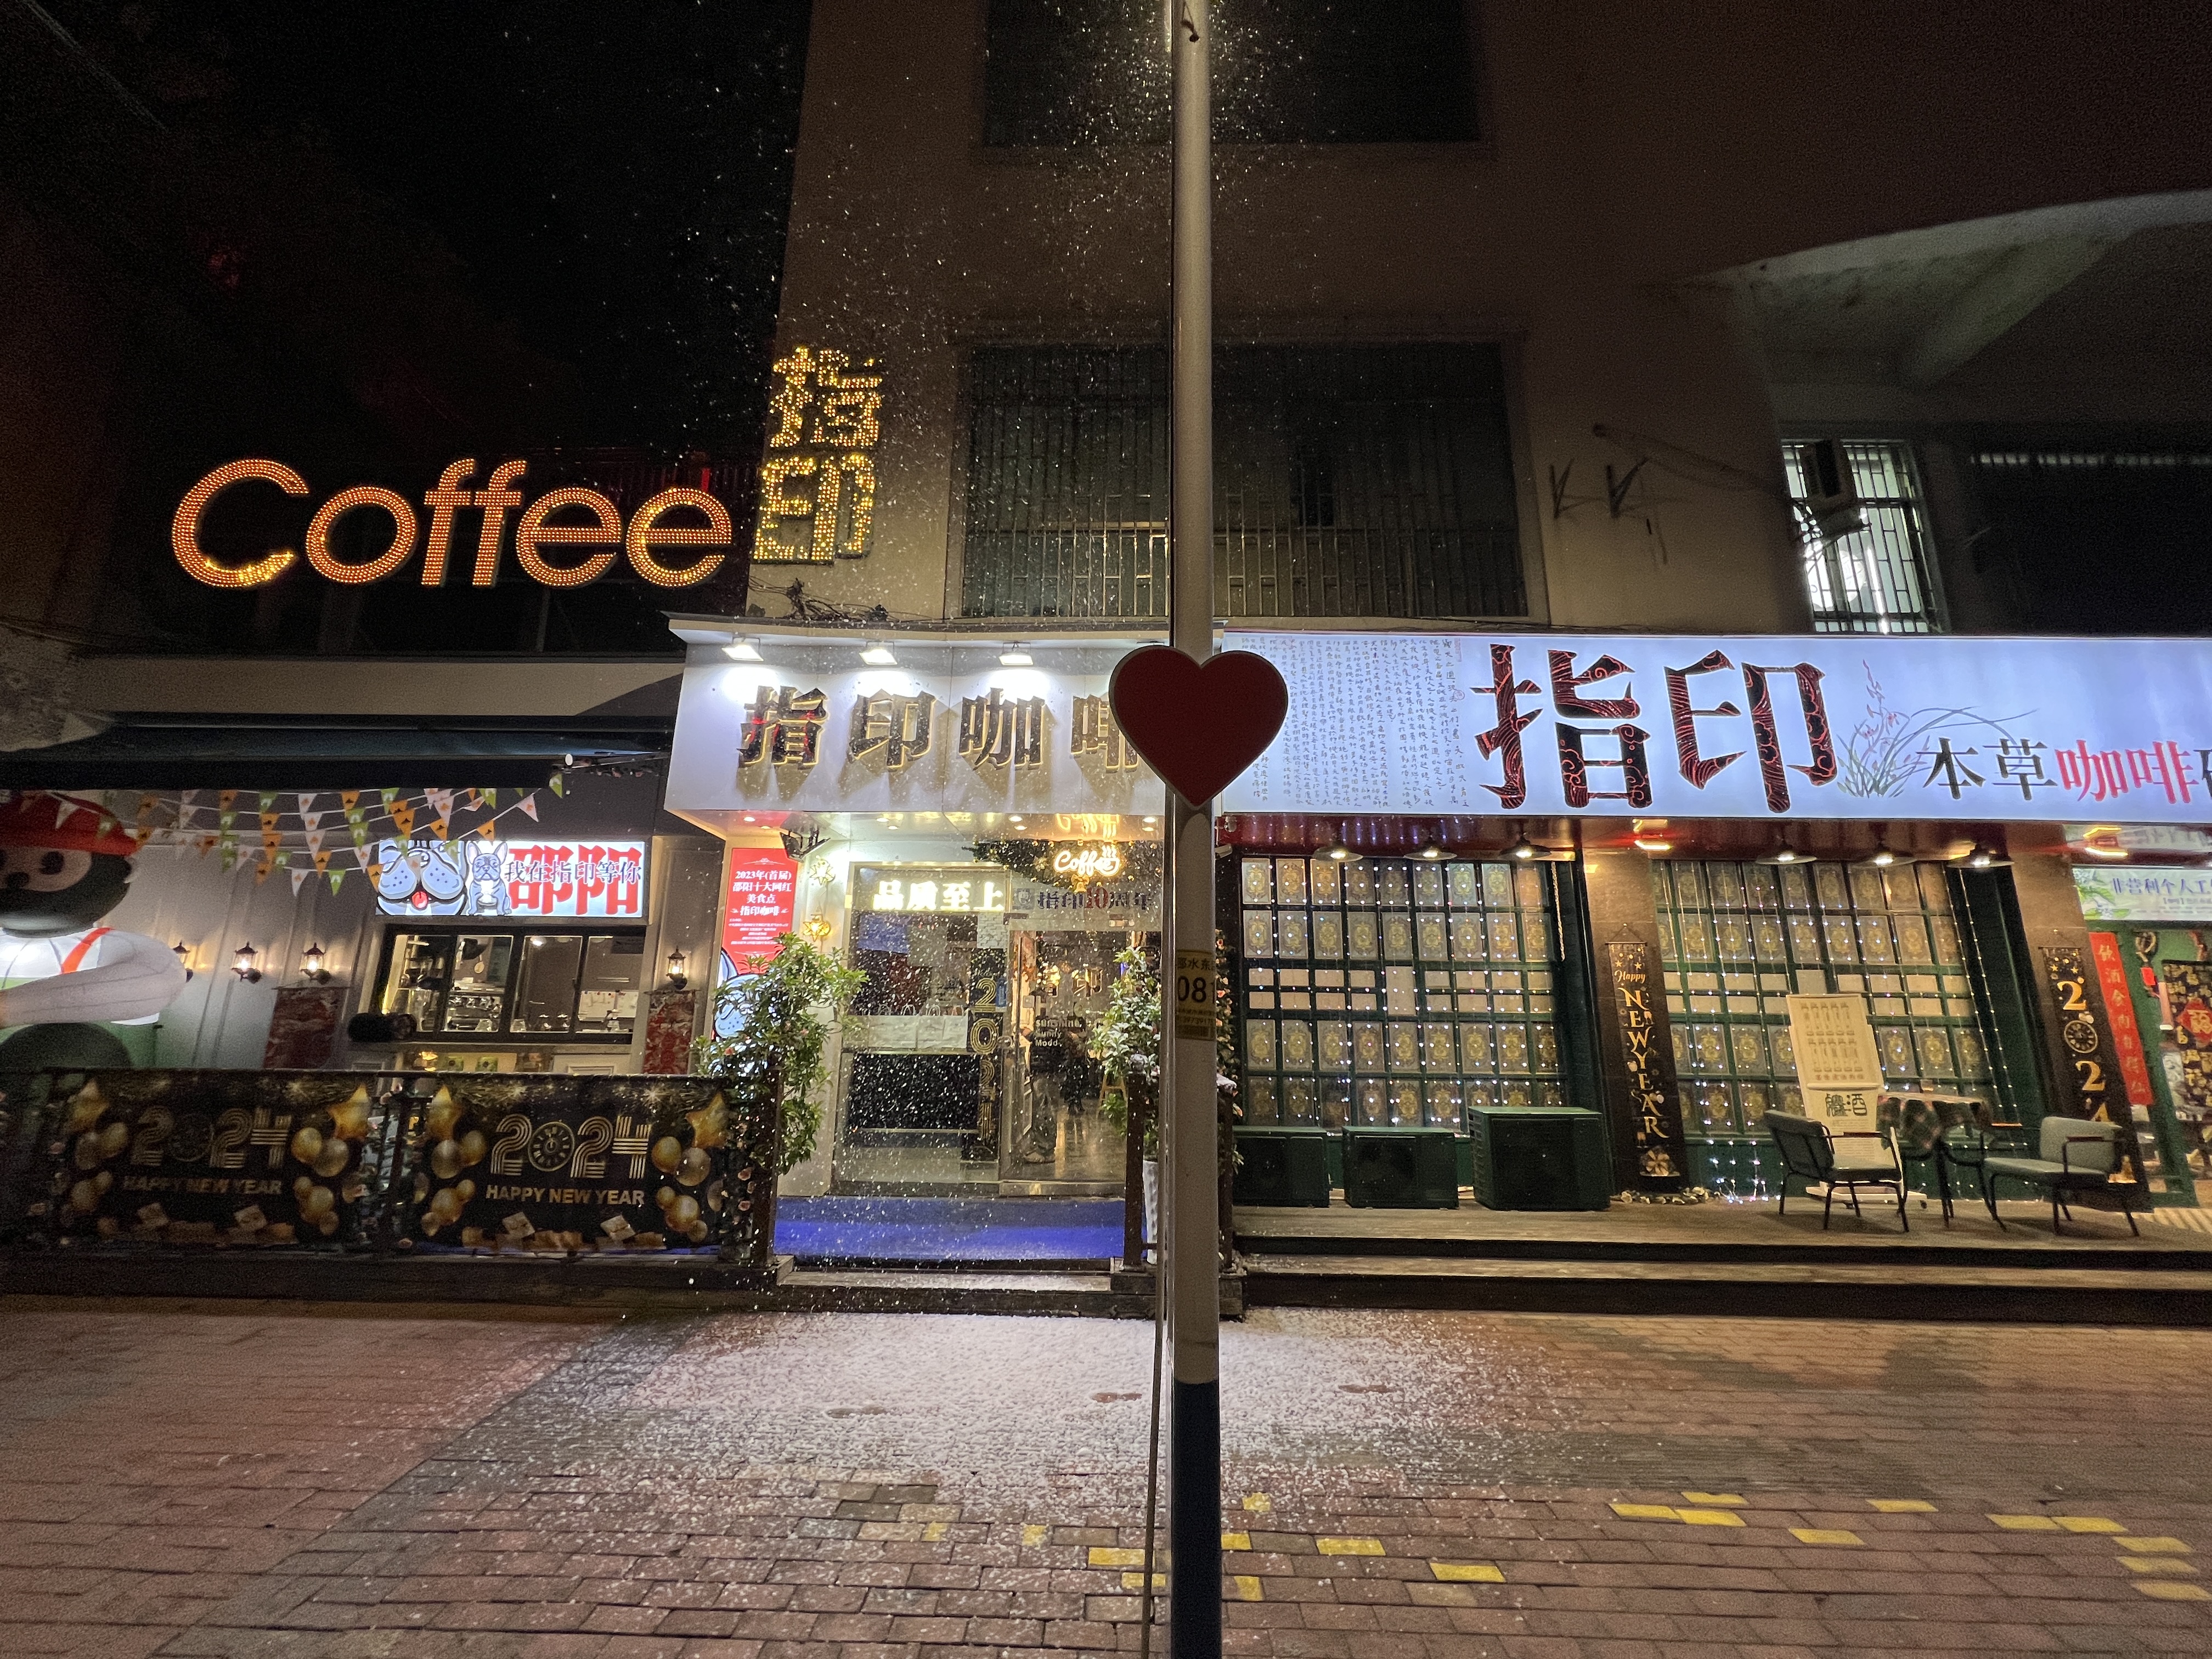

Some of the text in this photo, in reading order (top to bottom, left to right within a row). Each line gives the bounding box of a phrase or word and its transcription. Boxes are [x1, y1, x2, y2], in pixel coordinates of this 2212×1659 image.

[753, 346, 883, 561] 指印
[171, 458, 731, 588] Coffee
[738, 686, 1139, 770] 指印咖啡
[1469, 644, 1837, 813] 指印
[504, 860, 641, 885] 我在指印等你
[509, 844, 642, 915] 邵阳
[732, 882, 792, 892] 邵阳十大网红
[746, 894, 776, 904] 美食点
[873, 879, 1004, 912] 品质至上
[740, 905, 780, 916] 指印咖啡
[1615, 969, 1646, 984] Happy
[186, 1177, 229, 1194] NEW
[233, 1179, 283, 1195] YEAR
[486, 1184, 645, 1205] HAPPY NEW YEAR
